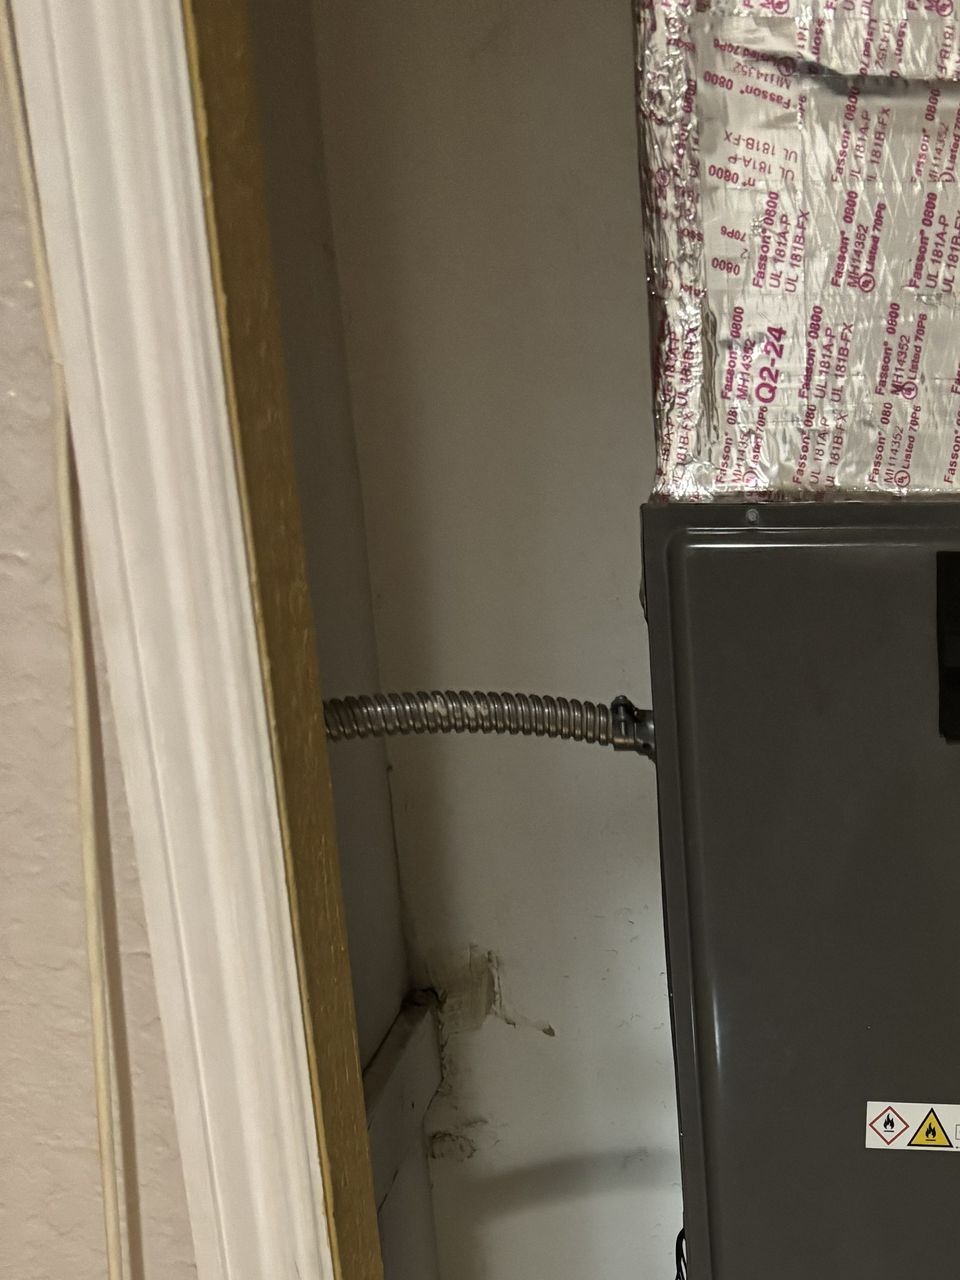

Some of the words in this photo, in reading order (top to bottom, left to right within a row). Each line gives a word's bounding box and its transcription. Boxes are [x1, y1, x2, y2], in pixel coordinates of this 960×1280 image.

[704, 71, 733, 90] 0800
[784, 148, 798, 163] UL
[780, 166, 795, 183] UL
[765, 191, 778, 225] 0800
[922, 192, 937, 227] 0800
[774, 215, 791, 264] 181A-P
[791, 210, 809, 268] 181B-FX
[931, 215, 949, 264] 181A-P
[769, 271, 782, 289] UL
[786, 275, 798, 292] UL
[927, 271, 939, 288] UL
[943, 275, 955, 292] UL
[731, 307, 744, 338] 0800
[809, 306, 823, 339] 0800
[887, 303, 900, 335] 0800
[916, 314, 927, 343] 70P6
[755, 326, 786, 403] Q2-24
[820, 328, 836, 377] 181A-P
[836, 323, 853, 379] 181B-FX
[815, 381, 827, 399] UL
[832, 385, 843, 402] UL
[909, 405, 921, 433] 70P6
